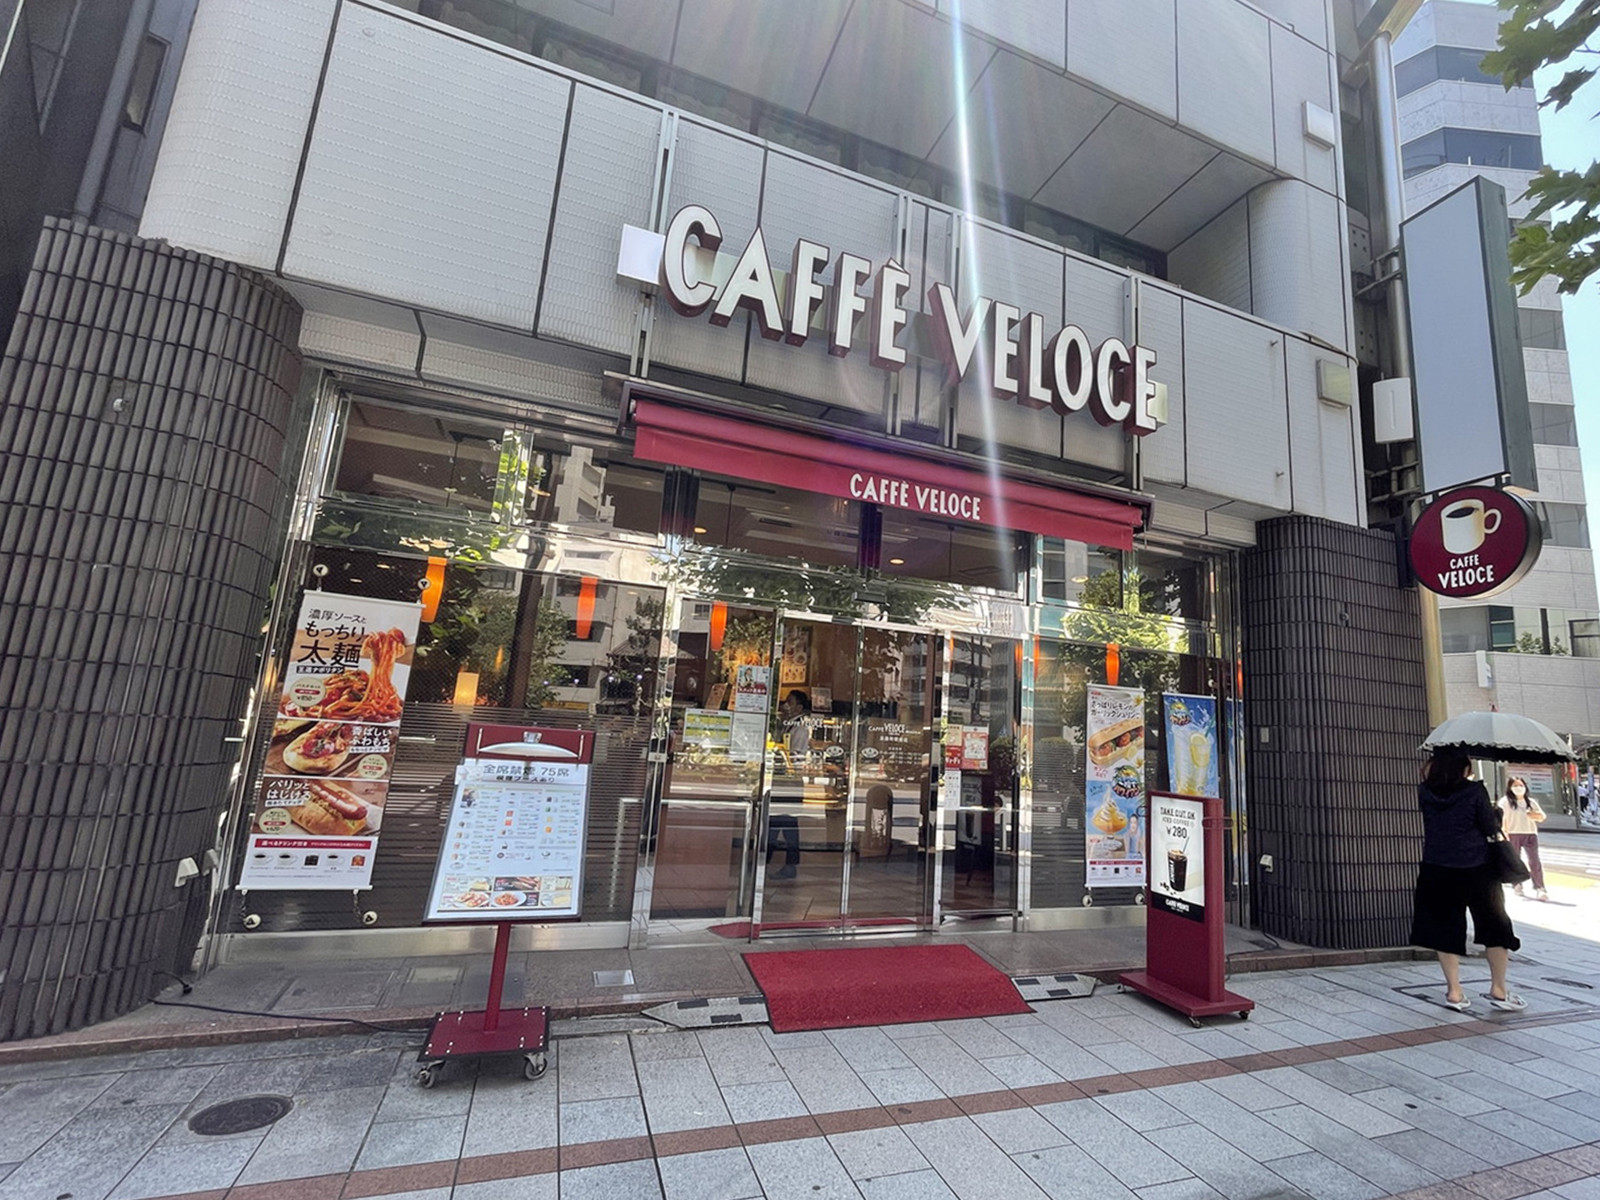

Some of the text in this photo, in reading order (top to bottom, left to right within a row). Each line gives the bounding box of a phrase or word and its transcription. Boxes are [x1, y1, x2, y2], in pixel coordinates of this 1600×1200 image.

[928, 281, 1158, 436] VELOCE
[914, 485, 981, 521] VELOCE
[1450, 553, 1480, 570] CAFFE
[1437, 564, 1495, 589] VELOCE
[308, 607, 367, 625] 濃厚ソースと
[304, 620, 365, 642] もっちり
[297, 639, 362, 668] 太麺
[349, 736, 391, 747] ふわもち
[482, 763, 571, 778] 全席禁煙 75席
[269, 779, 311, 791] パリッと
[267, 789, 313, 801] はじける
